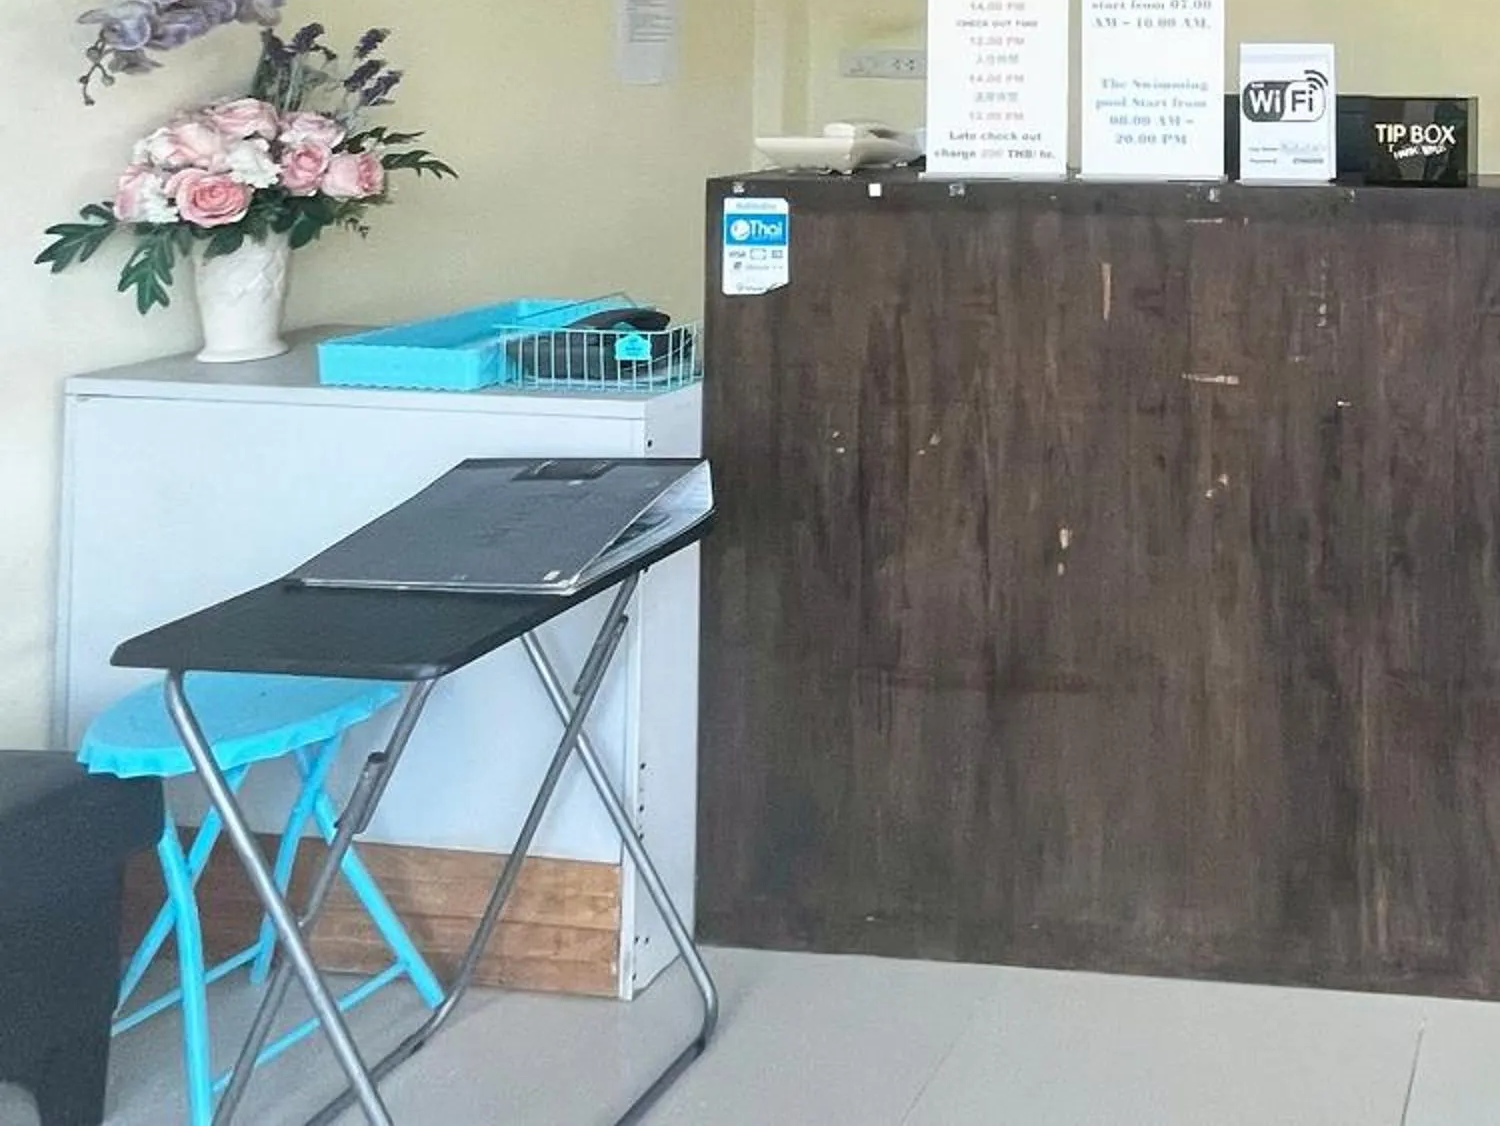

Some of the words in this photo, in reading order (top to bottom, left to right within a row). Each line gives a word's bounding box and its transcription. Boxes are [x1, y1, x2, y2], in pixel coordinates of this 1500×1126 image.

[1130, 0, 1165, 10] from
[1092, 17, 1117, 28] AM
[1102, 78, 1127, 89] The
[1132, 77, 1209, 92] Swimming
[1095, 96, 1126, 111] pool
[1172, 97, 1207, 108] from
[1157, 115, 1181, 126] AM
[980, 130, 1018, 141] check
[1021, 131, 1041, 141] out
[1161, 134, 1187, 145] PM
[1375, 124, 1406, 143] TIP
[1410, 124, 1456, 145] BOX
